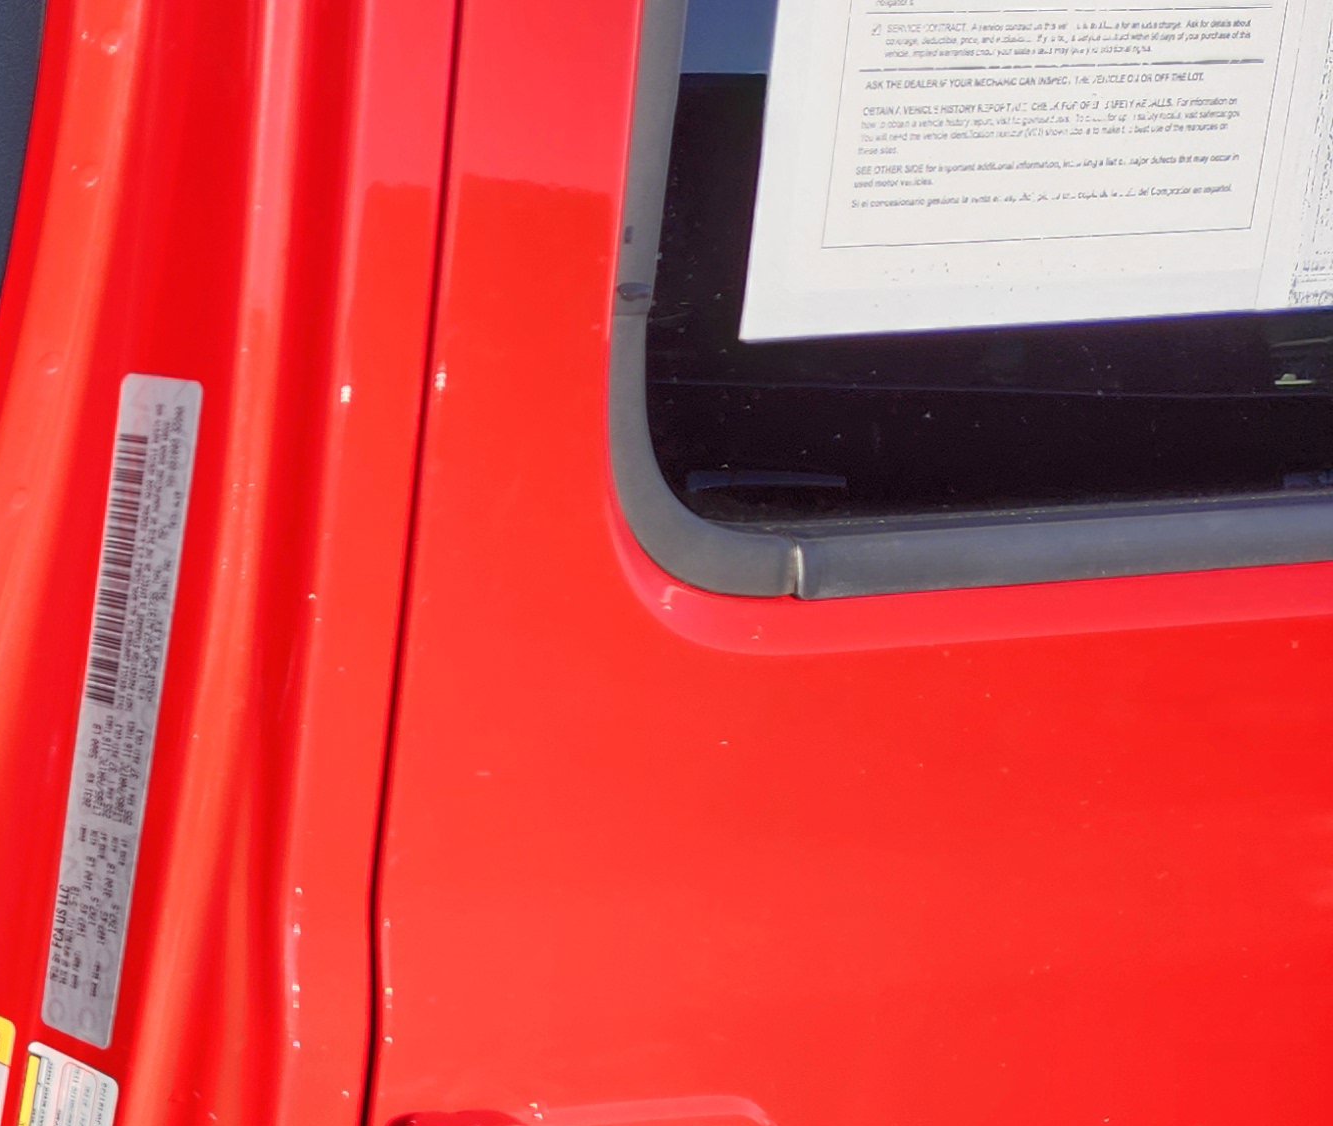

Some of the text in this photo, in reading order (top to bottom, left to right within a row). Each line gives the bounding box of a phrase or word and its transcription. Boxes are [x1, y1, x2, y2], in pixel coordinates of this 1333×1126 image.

[865, 80, 884, 90] ASK
[885, 80, 903, 90] THE
[904, 79, 938, 89] DEALER
[949, 78, 973, 88] YOUR
[1037, 75, 1071, 86] INSPEC
[1154, 73, 1171, 82] OFF
[939, 104, 976, 114] HISTORY
[855, 166, 872, 176] SEE
[873, 165, 903, 175] OTHER
[56, 882, 71, 906] LLC
[54, 906, 68, 925] US
[50, 924, 65, 949] FCA
